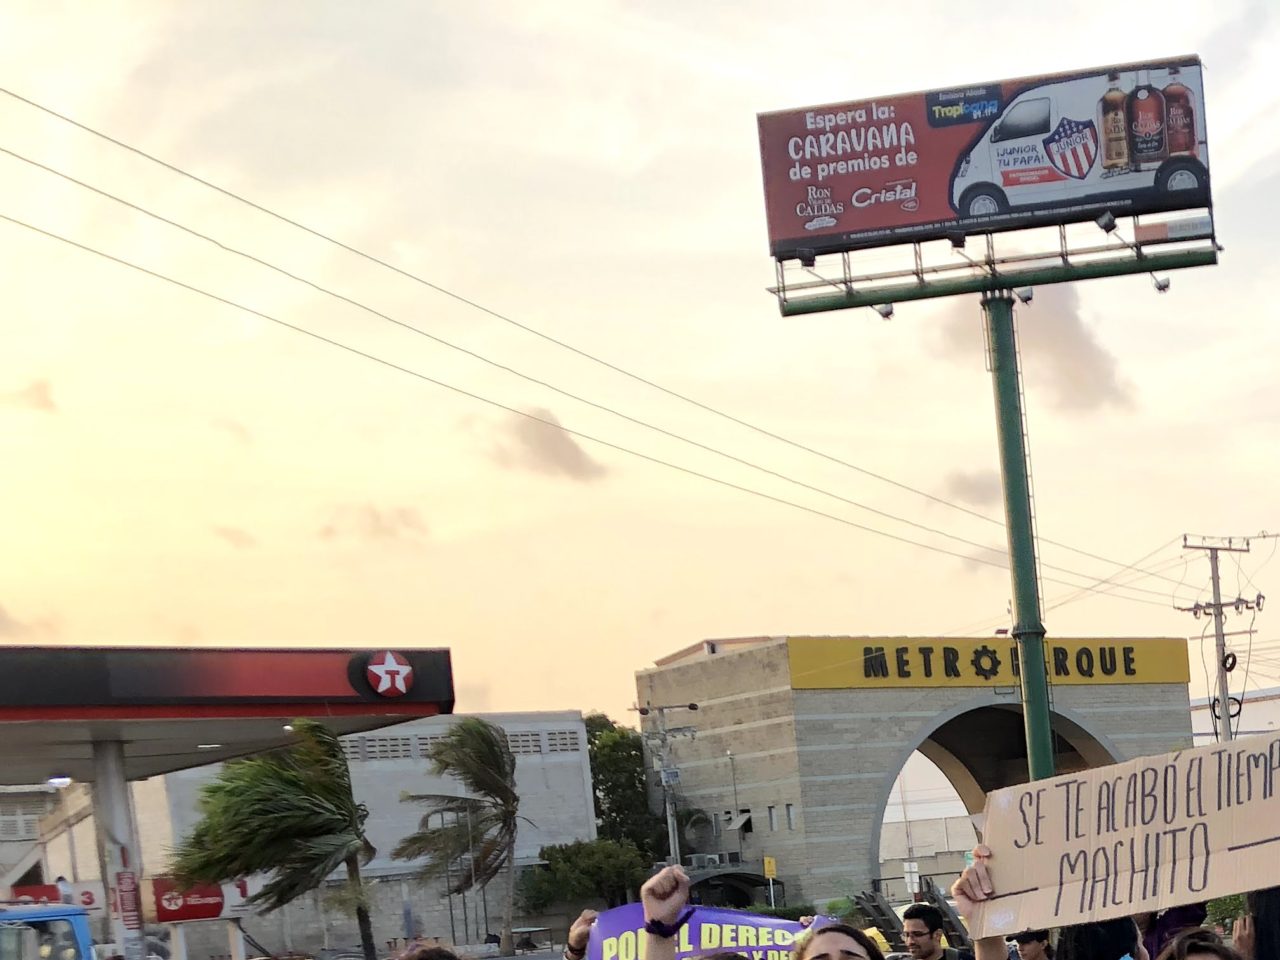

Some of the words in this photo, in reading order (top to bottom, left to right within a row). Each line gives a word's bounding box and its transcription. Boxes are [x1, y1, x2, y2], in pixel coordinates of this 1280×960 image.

[805, 109, 867, 131] Espera
[872, 102, 896, 120] la:
[788, 122, 915, 160] CARAVANA
[1055, 132, 1089, 153] JUNIOR
[789, 161, 812, 181] de
[817, 153, 890, 181] premios
[895, 147, 918, 166] de
[807, 186, 831, 199] RON
[852, 182, 917, 208] Cristal
[796, 202, 844, 217] CALDAS
[1014, 788, 1046, 849] SE
[1055, 780, 1088, 842] TE
[1097, 752, 1182, 836] ACABÓ
[1186, 757, 1208, 819] EL
[1054, 822, 1211, 917] MACHITO
[674, 923, 694, 953] L
